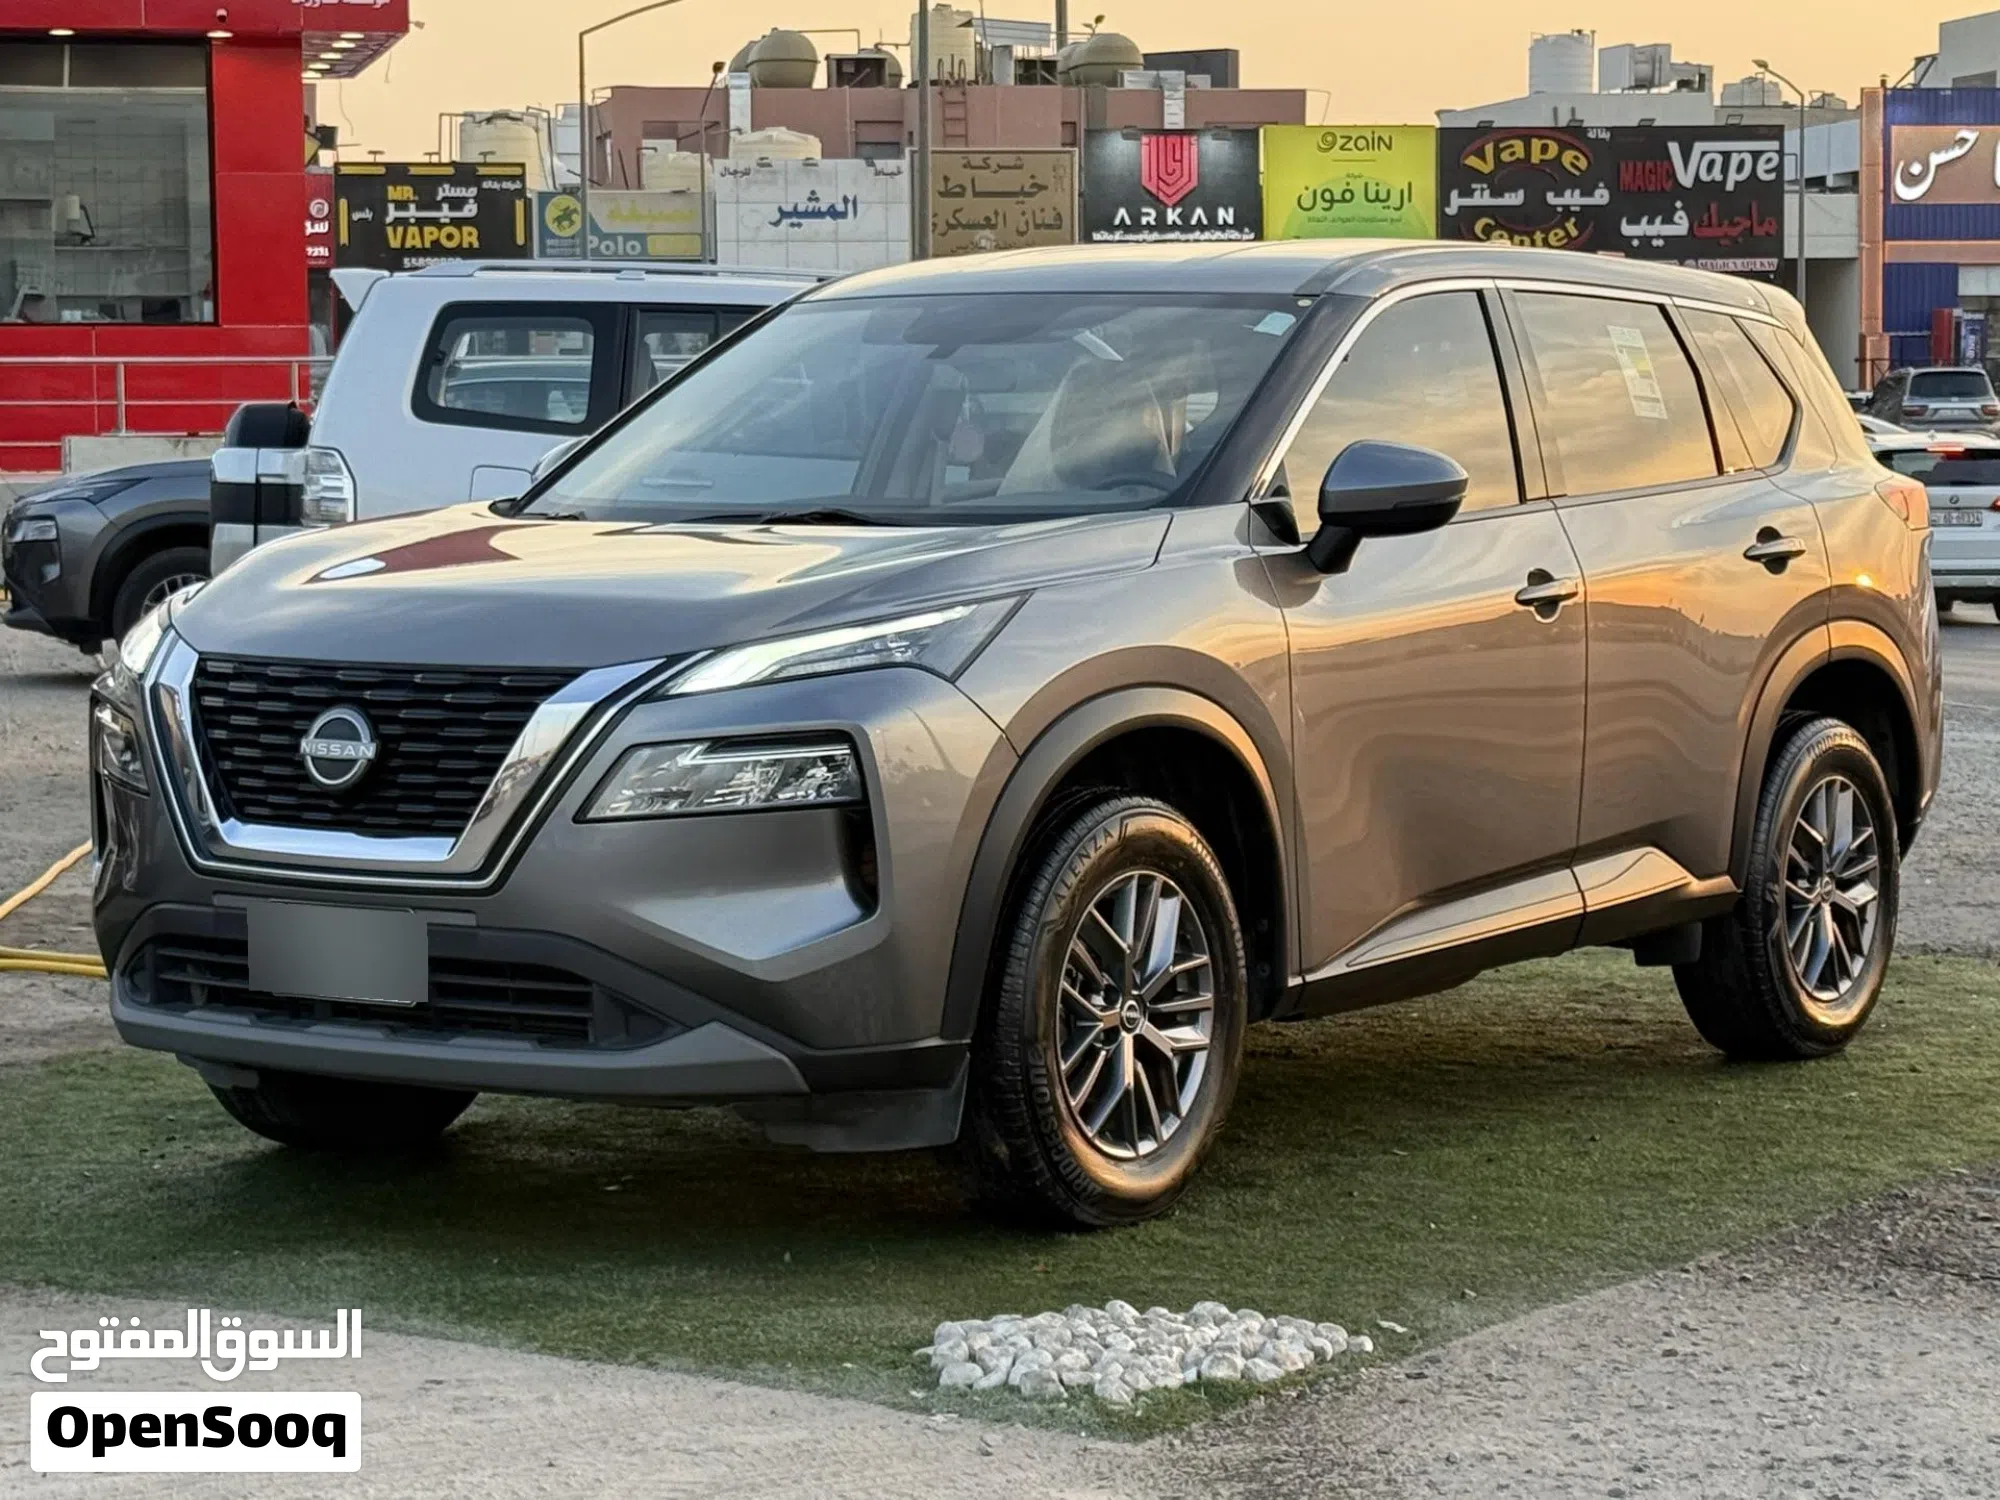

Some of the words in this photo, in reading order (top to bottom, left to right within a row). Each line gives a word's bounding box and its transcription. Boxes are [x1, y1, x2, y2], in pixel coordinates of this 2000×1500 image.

[961, 156, 1025, 174] شركة
[1463, 137, 1589, 177] Vape
[1618, 159, 1674, 193] MAGIC
[1666, 140, 1780, 192] Vape
[1894, 128, 1980, 202] حسن
[436, 183, 478, 201] مستر
[936, 174, 1049, 205] خياط
[1297, 181, 1355, 212] فون
[1364, 180, 1412, 211] ارينا
[1444, 183, 1525, 216] سنتر
[1546, 182, 1610, 212] فيب
[768, 189, 859, 228] المشير
[1016, 206, 1063, 237] فنان
[1113, 207, 1234, 226] ARKAN
[1620, 200, 1690, 247] فيب
[1693, 200, 1778, 246] ماجيك
[386, 226, 479, 248] VAPOR
[588, 236, 641, 255] Polo
[1474, 217, 1580, 247] Center
[301, 741, 374, 758] NISSAN
